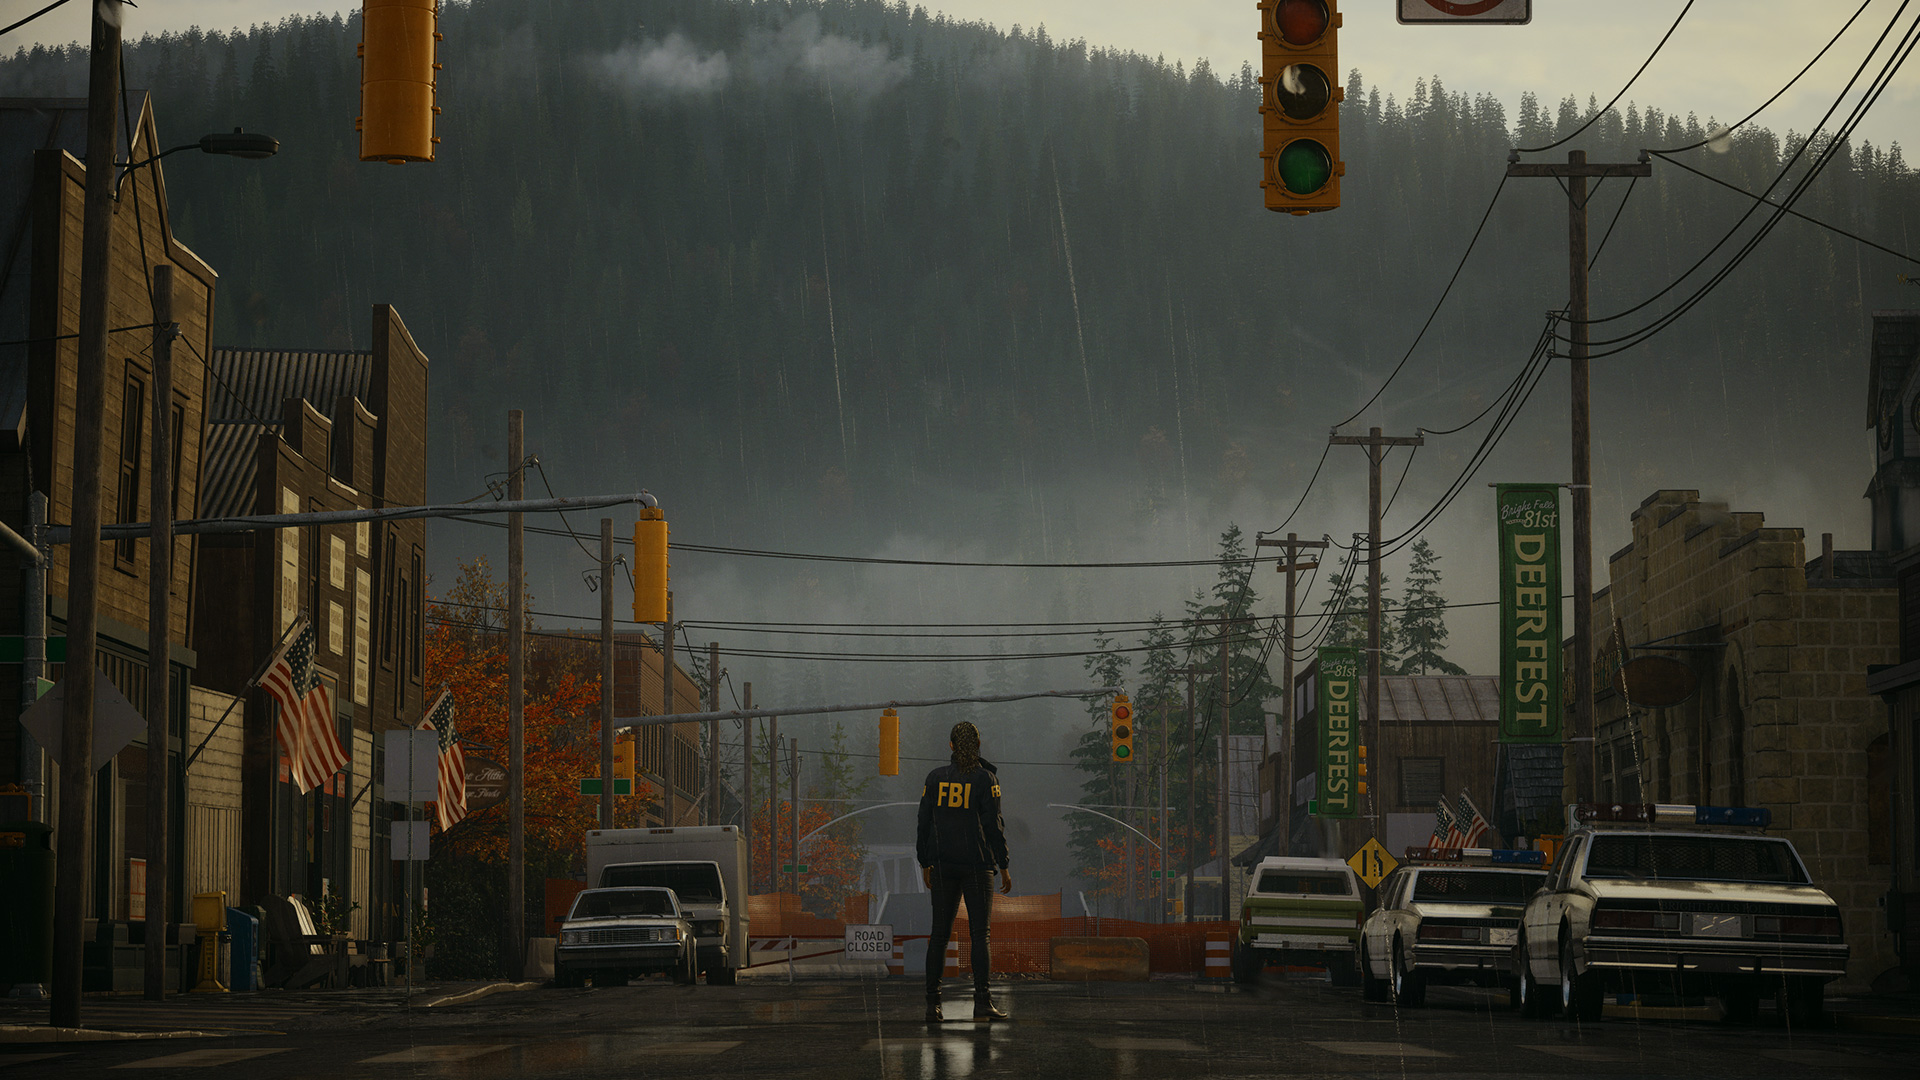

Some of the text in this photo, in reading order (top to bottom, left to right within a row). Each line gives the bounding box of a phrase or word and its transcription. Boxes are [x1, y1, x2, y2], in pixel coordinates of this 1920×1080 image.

[1501, 499, 1555, 520] Bright Falls
[1523, 510, 1557, 528] 81st
[1514, 533, 1548, 728] DEERFEST
[1334, 665, 1357, 677] 81st
[1327, 680, 1350, 809] DEERFEST
[937, 781, 972, 809] FBI
[1706, 903, 1740, 913] FALLS
[855, 930, 884, 941] ROAD
[847, 941, 891, 952] CLOSED
